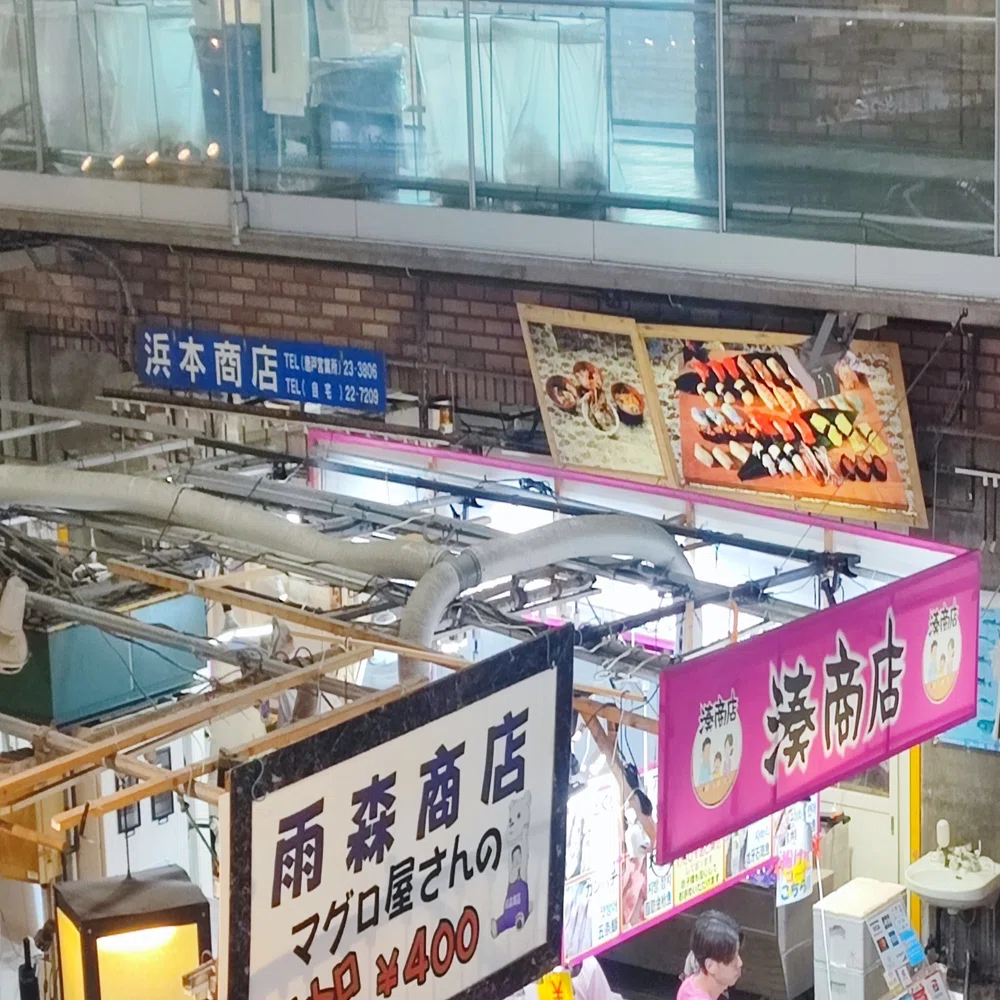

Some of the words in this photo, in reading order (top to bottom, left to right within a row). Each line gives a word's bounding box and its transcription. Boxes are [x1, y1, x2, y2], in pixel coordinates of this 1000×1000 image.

[144, 331, 278, 394] 浜本商店
[763, 612, 905, 778] 湊商店
[271, 707, 529, 908] 雨森商店
[291, 826, 502, 966] マグロ屋さんの
[376, 905, 480, 999] ¥400
